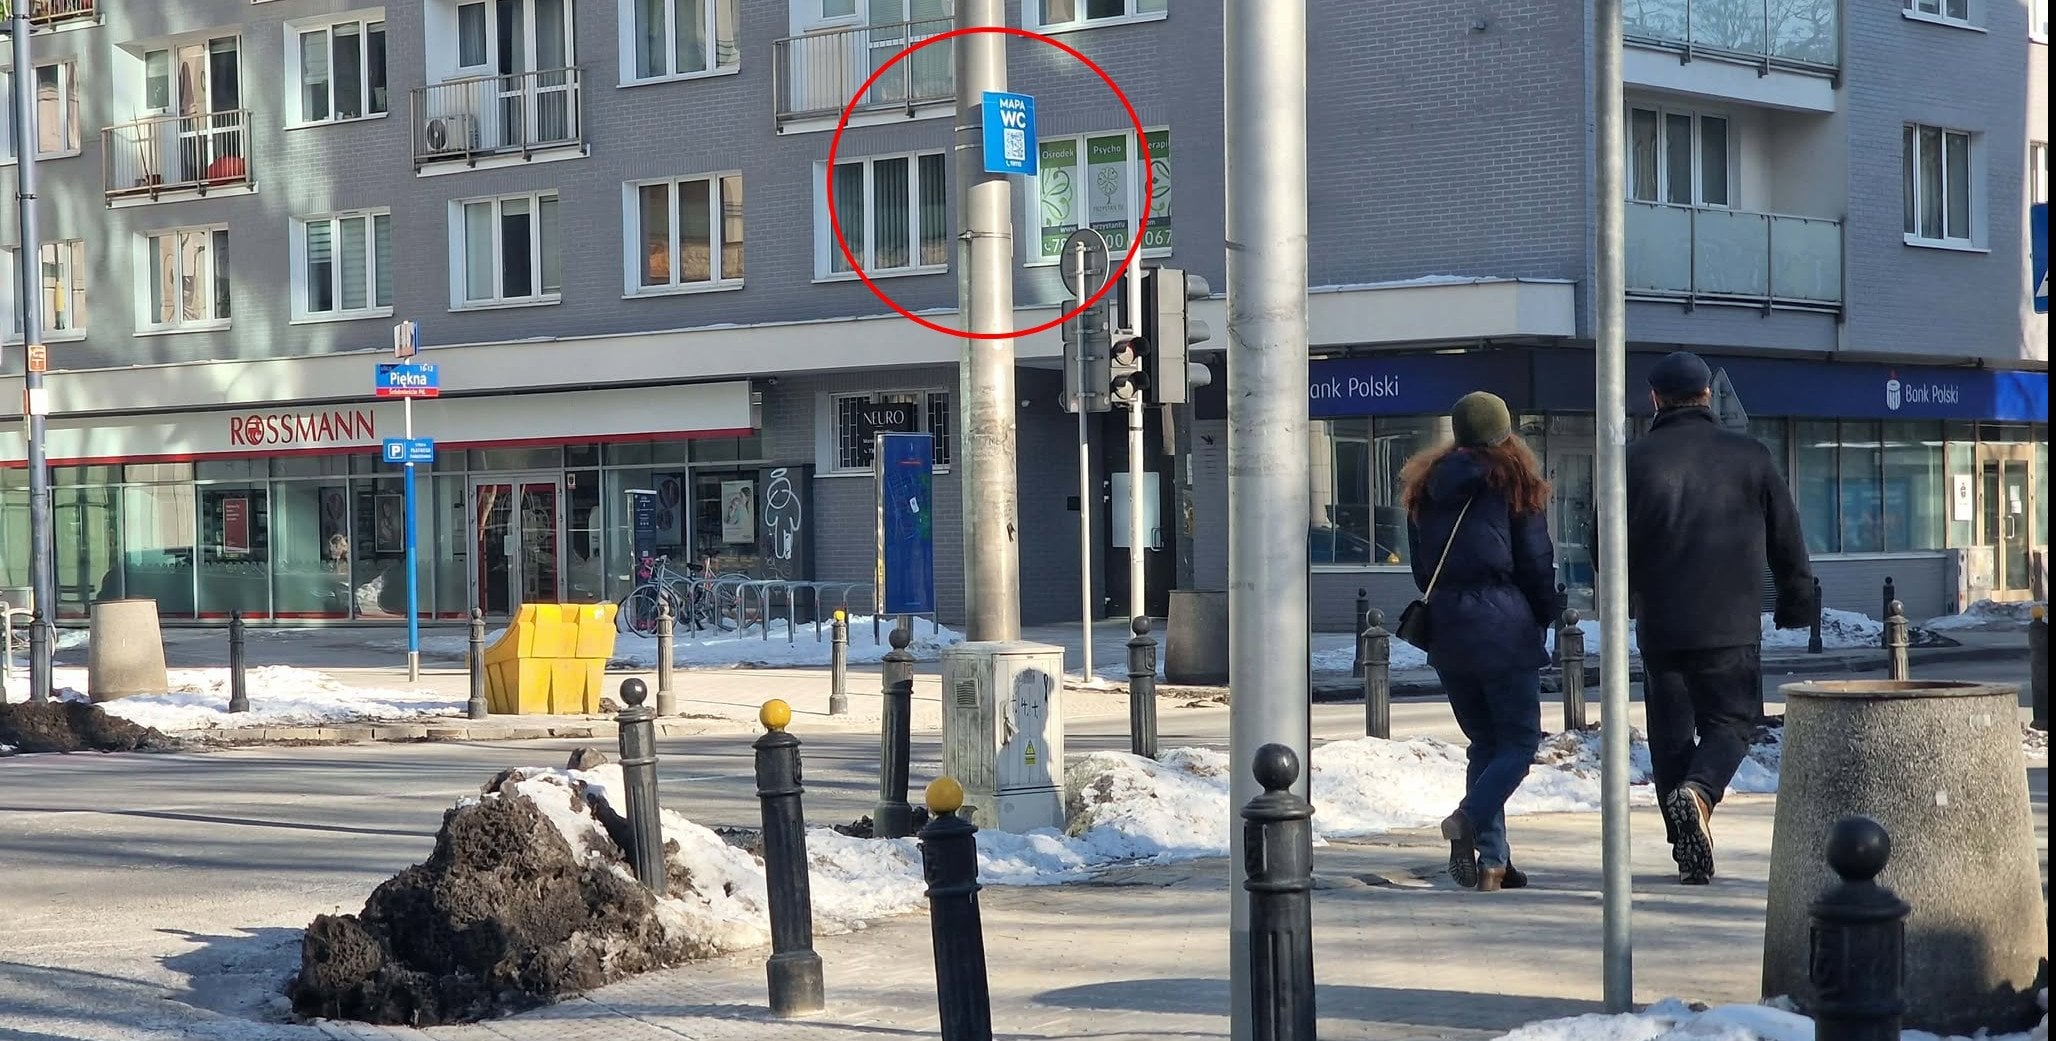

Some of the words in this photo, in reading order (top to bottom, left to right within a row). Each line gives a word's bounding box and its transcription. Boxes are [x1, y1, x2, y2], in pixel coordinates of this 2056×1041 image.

[999, 98, 1026, 111] MAPA
[1000, 110, 1026, 128] WC
[1093, 144, 1122, 156] Psycho
[390, 371, 427, 388] Piękna
[1310, 376, 1342, 399] ank
[1348, 374, 1400, 398] Polski
[1905, 383, 1929, 403] Bank
[1932, 384, 1959, 404] Polski
[863, 409, 905, 425] NEURO
[230, 409, 375, 446] ROSSMANN
